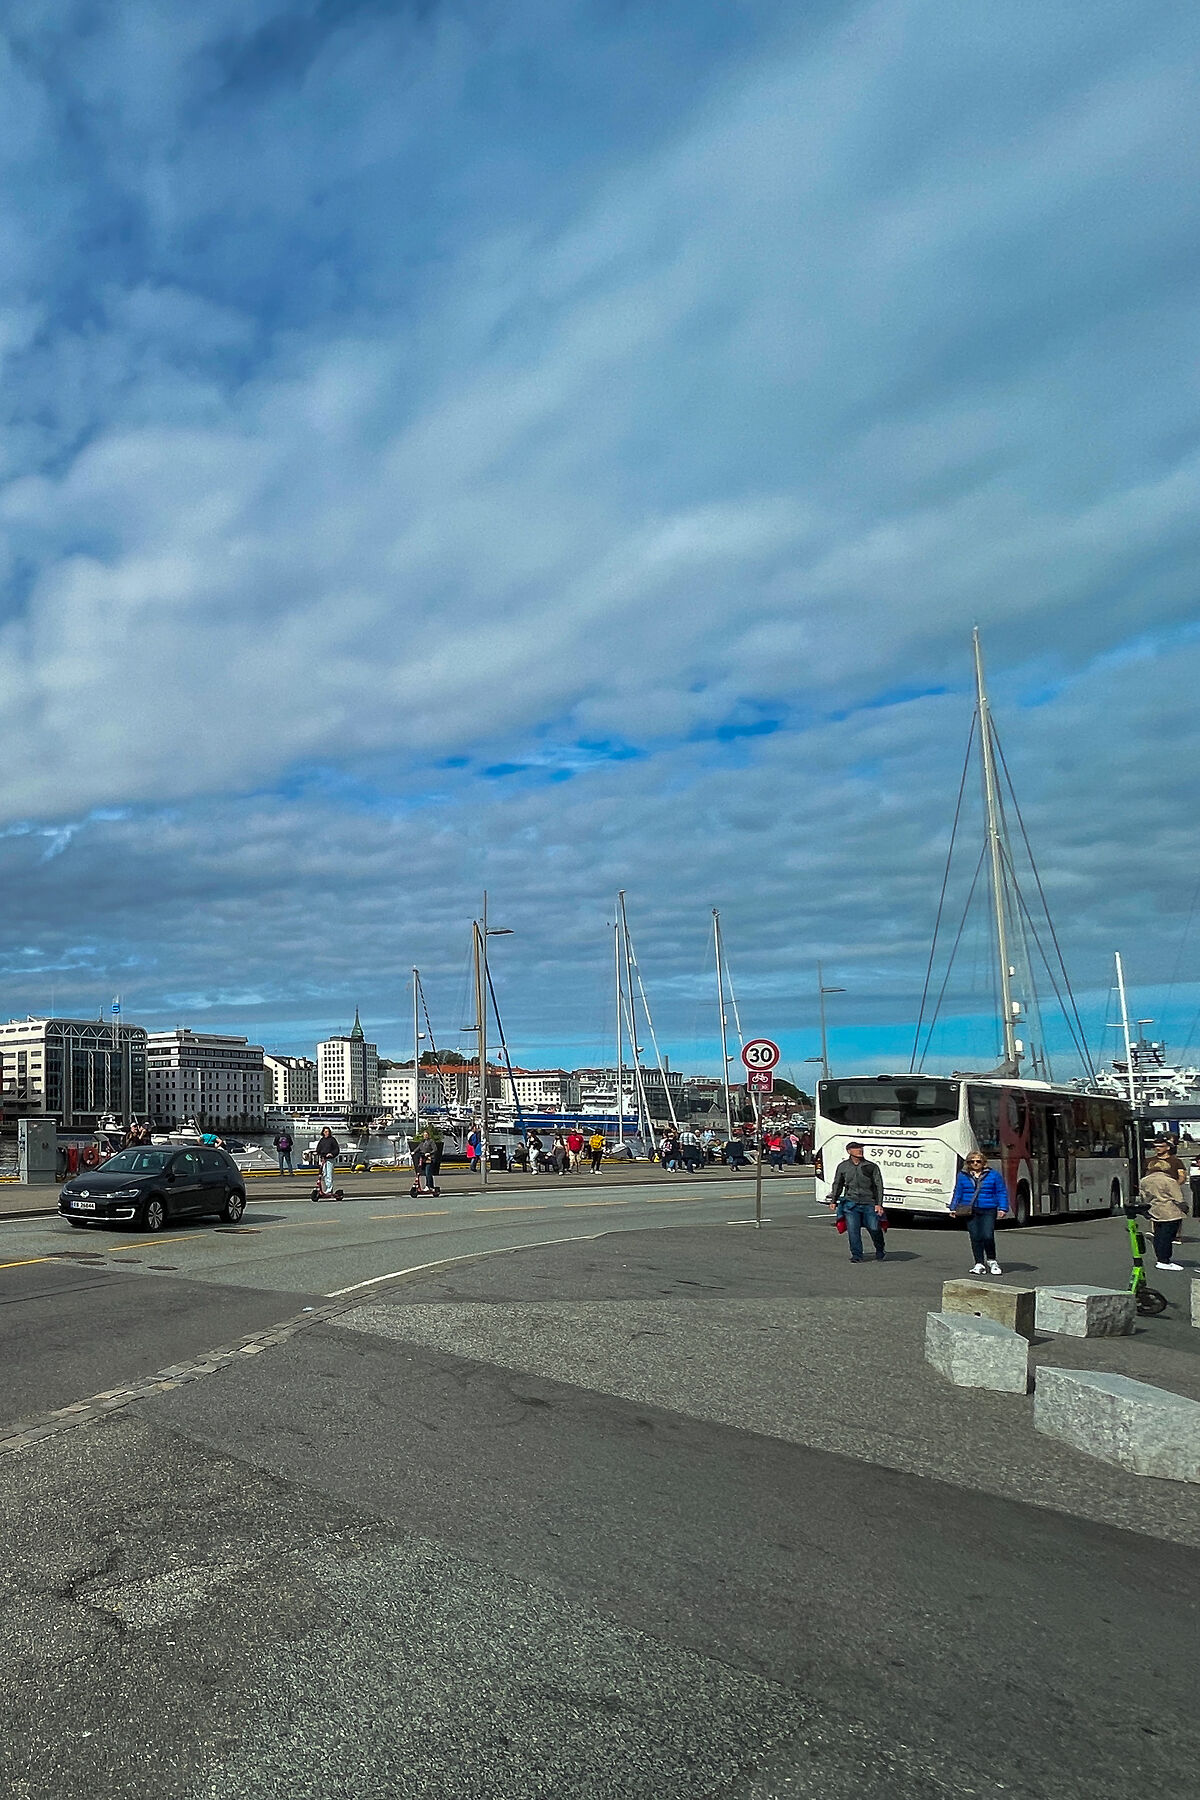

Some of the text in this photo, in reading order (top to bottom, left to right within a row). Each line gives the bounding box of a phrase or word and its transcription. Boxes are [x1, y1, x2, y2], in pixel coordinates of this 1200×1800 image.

[749, 1048, 773, 1063] 30
[870, 1148, 920, 1159] 59 90 60
[917, 1161, 934, 1169] hos
[914, 1177, 942, 1185] BOREAL
